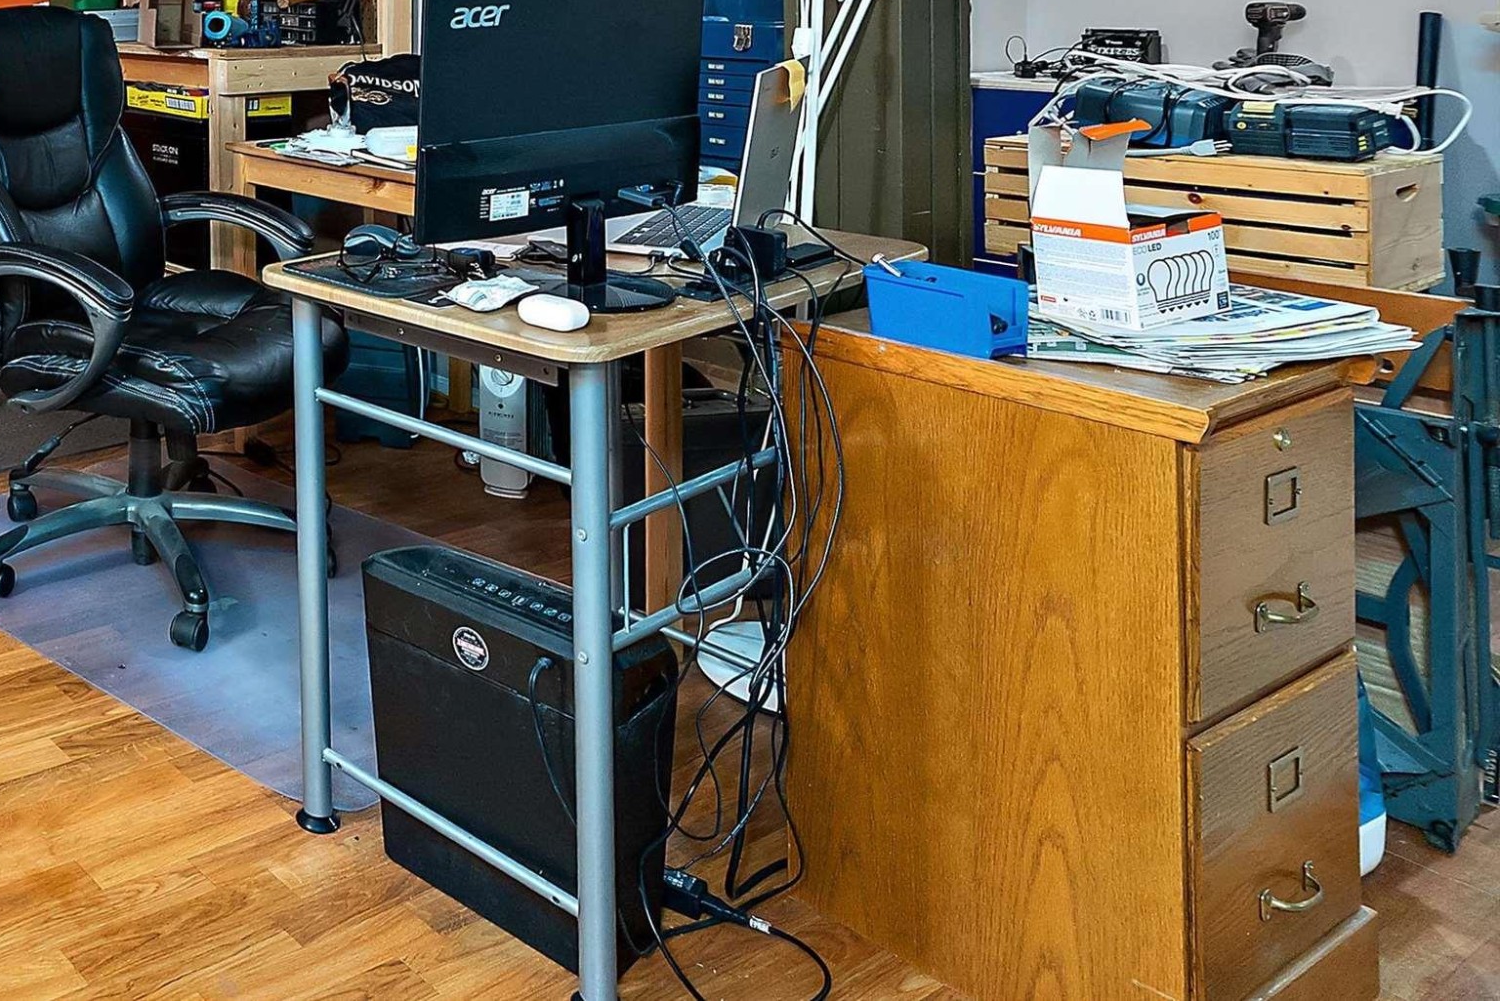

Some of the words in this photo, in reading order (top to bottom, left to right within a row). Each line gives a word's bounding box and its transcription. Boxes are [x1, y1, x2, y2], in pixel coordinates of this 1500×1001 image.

[450, 4, 510, 29] acer
[1032, 223, 1082, 237] SYLVANIA
[1131, 228, 1166, 243] SYLVANIA
